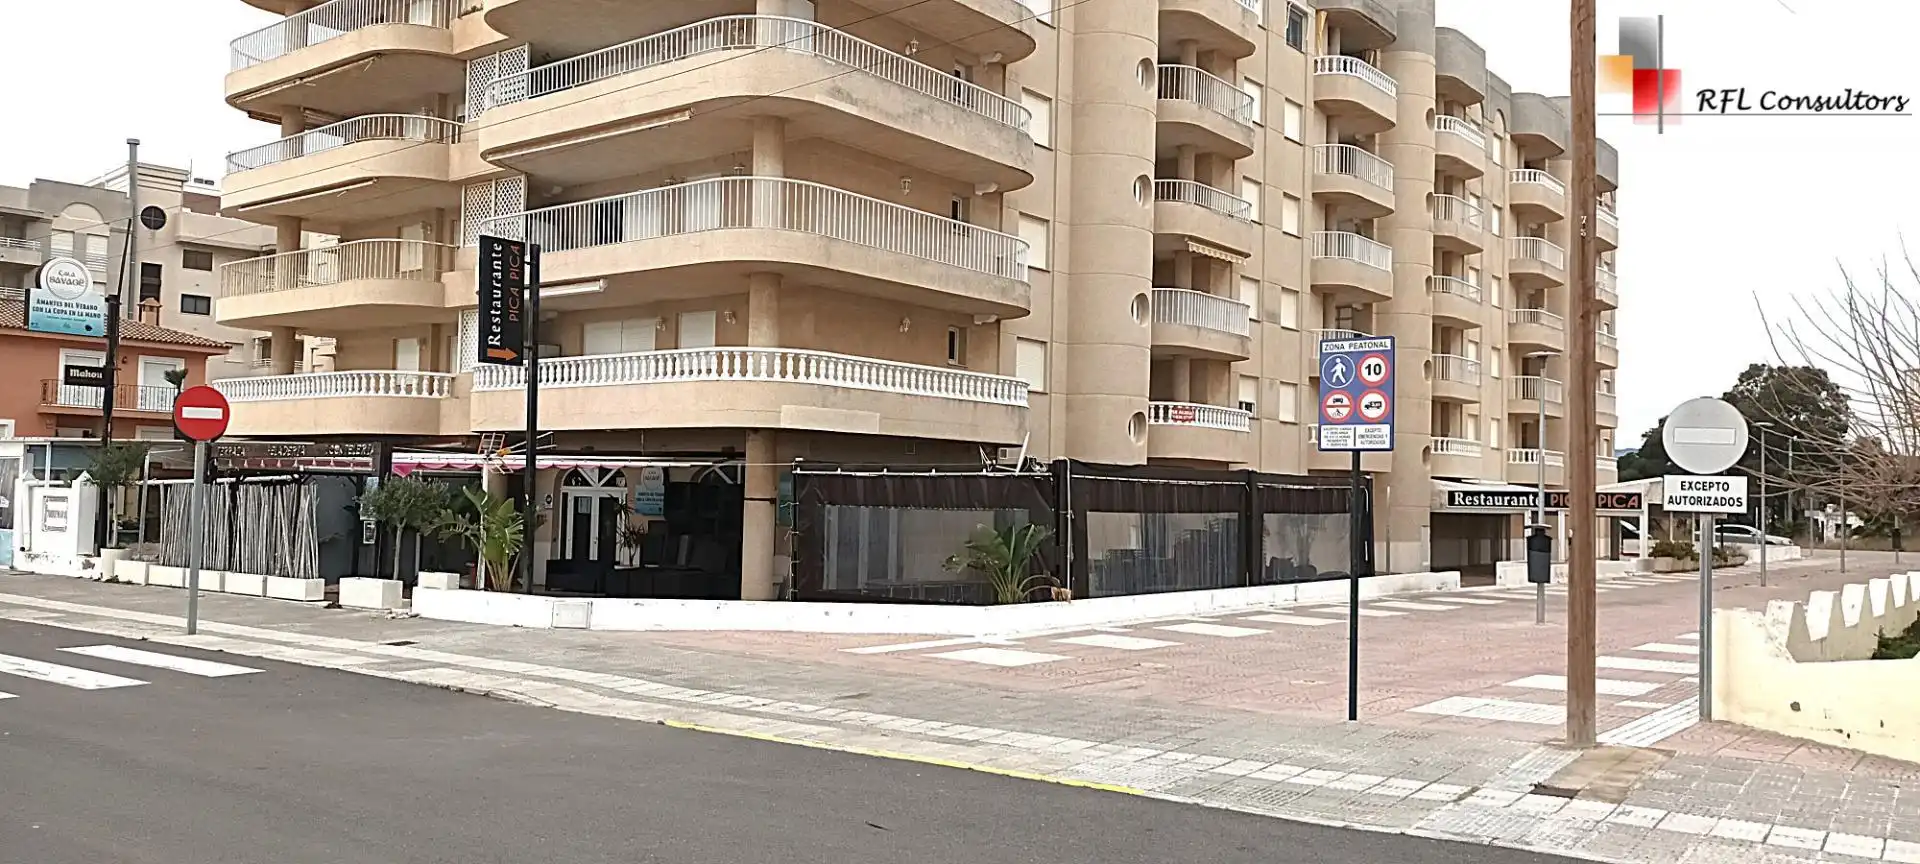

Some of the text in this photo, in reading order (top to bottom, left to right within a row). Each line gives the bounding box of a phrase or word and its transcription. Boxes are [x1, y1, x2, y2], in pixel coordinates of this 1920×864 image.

[508, 244, 521, 321] PICA PICA
[487, 242, 502, 346] Restaurante
[1324, 341, 1388, 352] ZONA PEATONAL
[70, 368, 103, 379] Mahou
[1364, 363, 1382, 376] 10
[1680, 480, 1730, 492] EXCEPTO
[1597, 494, 1640, 509] PICA
[1667, 495, 1743, 508] AUTORIZADOS
